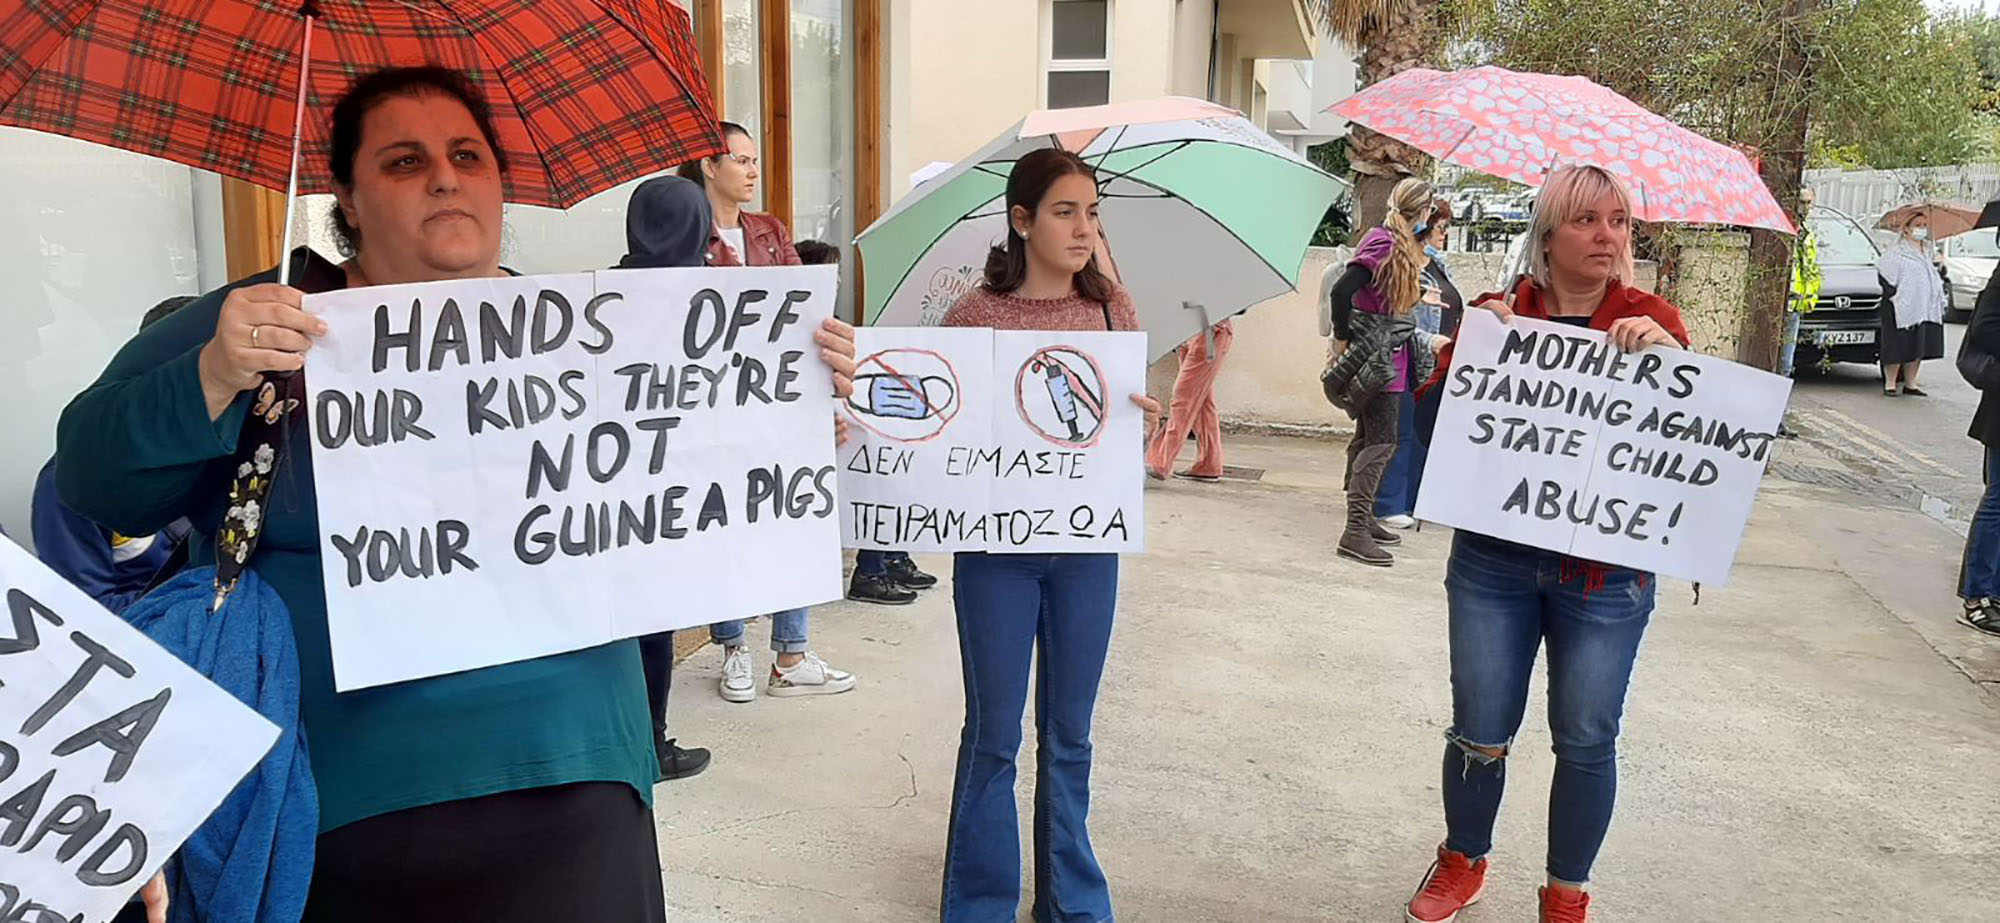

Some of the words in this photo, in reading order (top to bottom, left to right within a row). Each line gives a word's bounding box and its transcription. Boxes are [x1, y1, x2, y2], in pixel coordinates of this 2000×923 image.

[371, 289, 624, 373] HANDS
[682, 287, 812, 359] OFF
[1497, 329, 1702, 398] MOTHERS
[315, 387, 436, 449] OUR
[466, 368, 586, 435] KIDS
[614, 350, 806, 412] THEY'RE
[1449, 364, 1633, 426] STANDING
[1636, 406, 1776, 462] AGAINST
[525, 416, 682, 498] NOT
[847, 444, 915, 476] ΔΕΝ
[946, 445, 1086, 478] ΕΙΜΑΣΤΕ
[1468, 412, 1588, 458] STATE
[1606, 441, 1720, 486] CHILD
[330, 519, 480, 588] YOUR
[513, 485, 729, 564] GUINEA
[746, 463, 836, 524] PIGS
[1501, 477, 1684, 545] ABUSE!
